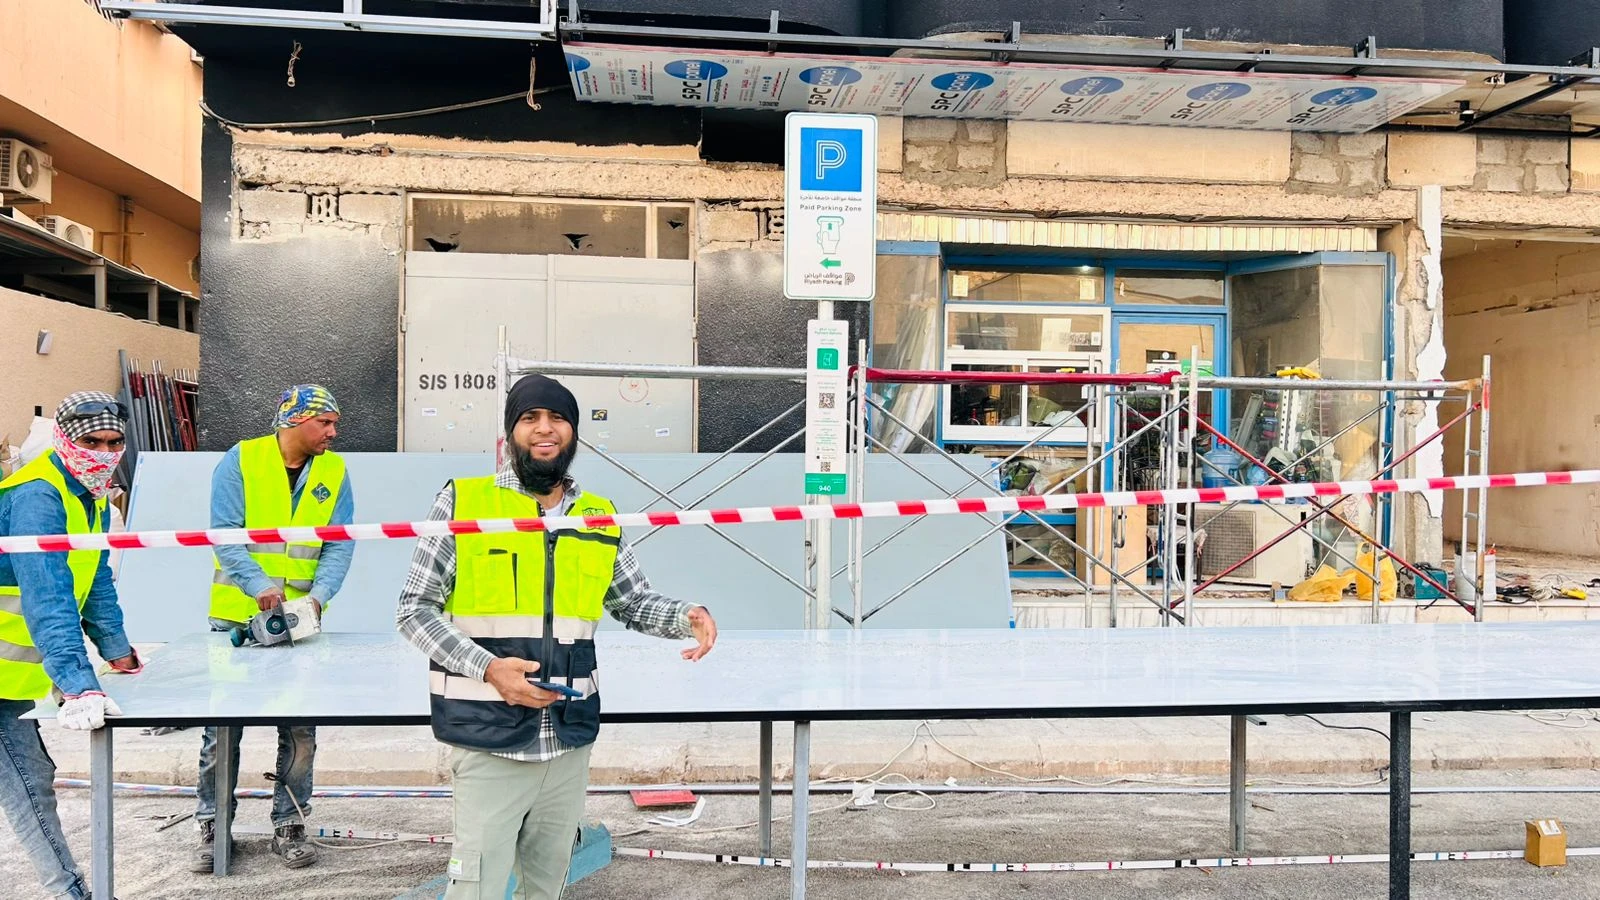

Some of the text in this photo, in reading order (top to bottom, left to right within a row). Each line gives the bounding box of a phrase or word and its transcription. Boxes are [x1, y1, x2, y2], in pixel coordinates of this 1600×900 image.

[682, 81, 702, 100] SPC
[808, 87, 832, 106] SPC
[931, 92, 959, 110] SPC
[1051, 97, 1084, 115] SPC
[1170, 102, 1207, 119] SPC
[1286, 106, 1328, 124] SPC
[816, 140, 847, 179] P
[816, 204, 843, 212] Parking
[419, 374, 496, 390] S/S 1808
